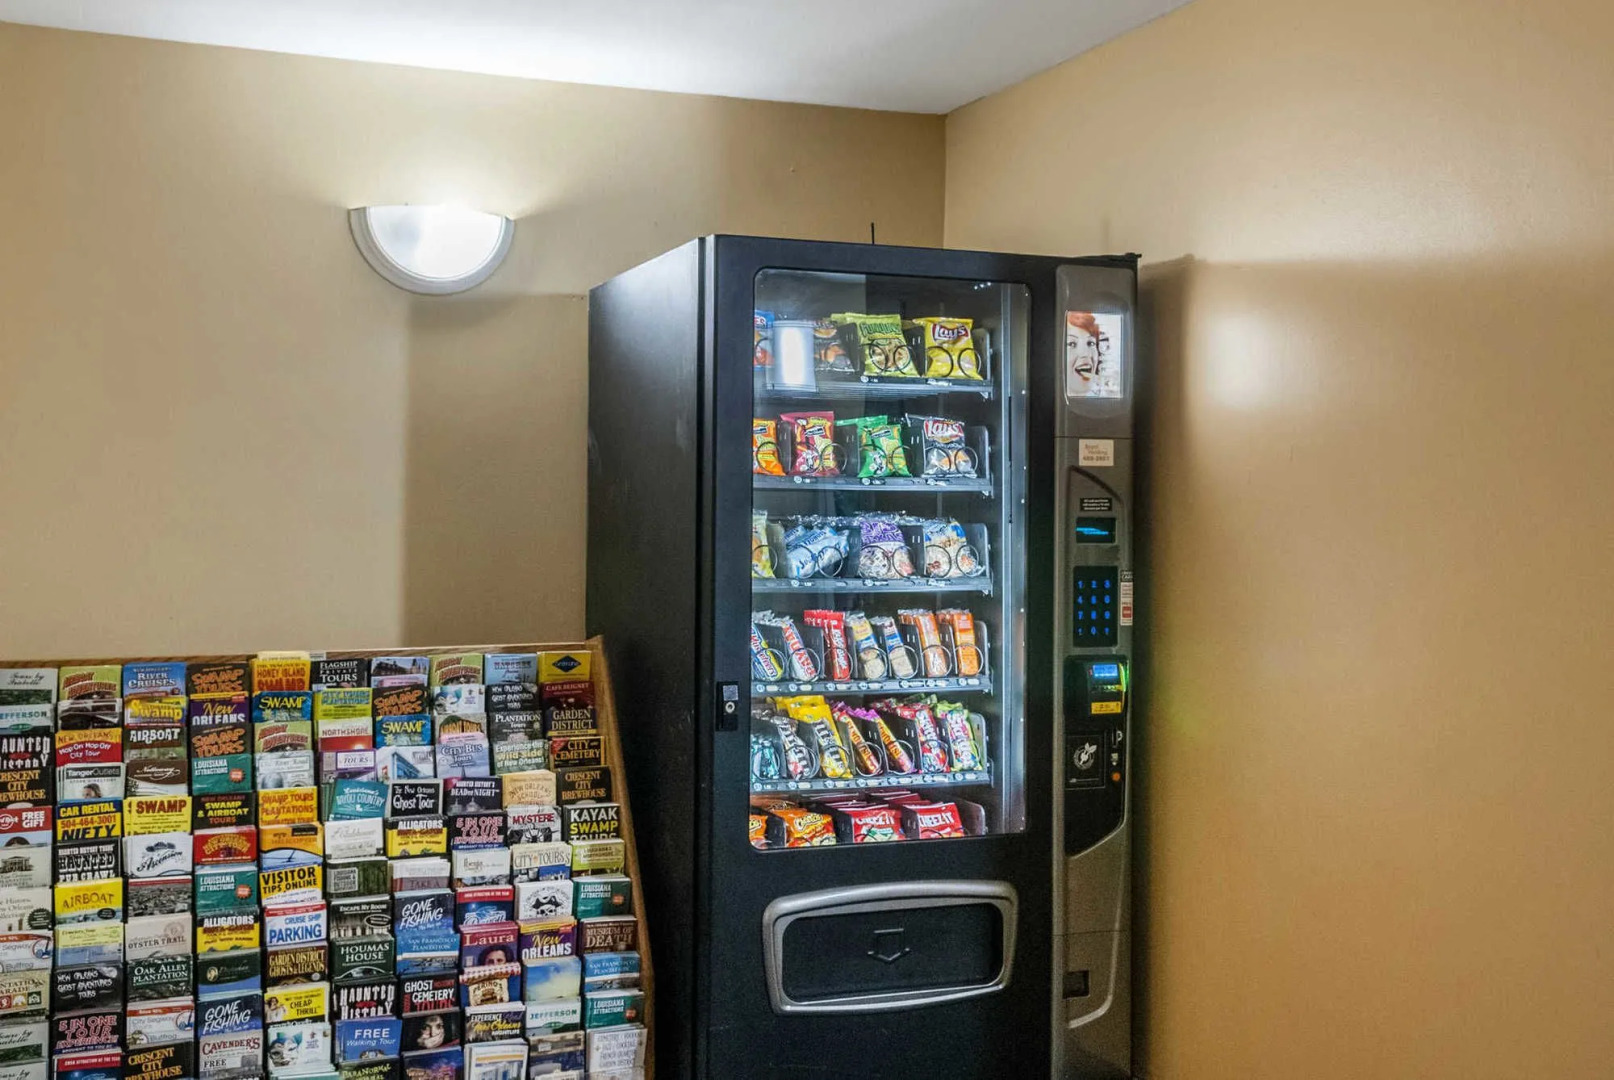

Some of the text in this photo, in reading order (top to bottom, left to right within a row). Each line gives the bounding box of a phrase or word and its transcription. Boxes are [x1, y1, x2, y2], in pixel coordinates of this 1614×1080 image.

[933, 323, 970, 342] Lay's
[320, 660, 358, 670] FLAGSHIP
[138, 672, 168, 680] RIVER
[191, 669, 244, 684] SWAMP
[320, 674, 358, 683] TOURS
[129, 679, 176, 689] CRUISES
[195, 680, 243, 693] TOURS
[563, 682, 589, 690] BEIGNET
[260, 696, 306, 710] SWAMP
[373, 689, 423, 709] SWAMP
[130, 699, 183, 721] Swamp
[203, 702, 237, 716] New
[377, 700, 423, 717] TOURS
[553, 709, 591, 721] GARDEN
[0, 711, 47, 720] EFFERSON
[495, 713, 541, 723] PLANTATION
[381, 720, 425, 733] SWAMP
[551, 719, 593, 731] DISTRICT
[58, 731, 111, 743] NEW ORLEANS
[129, 728, 181, 744] AIRBOAT
[191, 727, 245, 747] SWAMP
[322, 727, 369, 737] NORTHSHORE
[197, 741, 245, 758] TOURS
[567, 740, 589, 750] CITY
[69, 749, 101, 759] City Tour
[554, 748, 600, 761] CEMETERY
[194, 759, 228, 769] LOUISIANA
[0, 769, 41, 781] RESCENT
[66, 766, 120, 778] TangerOutlets
[195, 767, 228, 775] ATTRACTIONS
[565, 771, 601, 782] CRESCENT
[7, 780, 29, 792] CITY
[404, 785, 435, 794] New Orleans
[575, 780, 592, 789] CITY
[290, 793, 314, 802] TOURS
[473, 788, 496, 796] NIGHT
[561, 788, 606, 800] BREWHOUSE
[136, 799, 187, 815] SWAMP
[205, 801, 242, 810] SWAMP
[336, 793, 386, 808] BAYOU COUNTRY
[393, 794, 435, 811] Ghost Tour
[22, 810, 45, 820] FREE
[60, 802, 116, 817] CAR RENTAL
[197, 808, 249, 818] & AIRBOAT
[570, 807, 618, 823] KAYAK
[22, 818, 45, 829] GIFT
[209, 816, 237, 824] TOURS
[397, 820, 444, 830] ALLIGATORS
[478, 816, 503, 828] ONE
[513, 813, 555, 825] MYSTERE
[61, 825, 116, 841] NIFTY
[461, 826, 498, 839] TOUR
[569, 821, 619, 835] SWAMP
[58, 852, 115, 873] HAUNTED
[514, 855, 533, 869] CITY
[538, 851, 565, 865] TOURS
[58, 869, 116, 882] PUB CRAWL
[200, 875, 235, 885] LOUISIANA
[262, 867, 316, 887] VISITOR
[200, 883, 236, 892] ATTRACTIONS
[263, 878, 317, 894] TIPS ONLINE
[581, 884, 612, 892] LOUISIANA
[62, 892, 115, 909] AIRBOAT
[580, 890, 611, 899] ATTRACTIONS
[339, 903, 388, 913] ESCAPE ROOM
[401, 898, 435, 917] GONE
[203, 916, 255, 929] ALLIGATORS
[284, 913, 322, 926] CRUISE SHIP
[400, 908, 444, 930] FISHING
[269, 924, 323, 944] PARKING
[587, 927, 621, 937] MUSEUM
[623, 926, 632, 934] OF
[128, 937, 186, 949] OYSTER TRAIL
[464, 934, 515, 946] Laura
[532, 934, 565, 948] New
[586, 934, 632, 948] DEATH
[340, 942, 390, 955] HOUMAS
[521, 943, 572, 960] ORLEANS
[269, 949, 325, 967] GARDEN DISTRICT
[345, 951, 384, 964] HOUSE
[134, 963, 187, 976] OAK ALLEY
[298, 961, 325, 973] LEGENDS
[132, 971, 188, 984] PLANTATION
[57, 984, 76, 993] GHOST
[404, 979, 434, 993] GHOST
[78, 990, 97, 999] TOURS
[340, 984, 395, 1006] HAUNTED
[411, 988, 455, 1003] CEMETERY
[205, 1000, 242, 1020] GONE
[289, 999, 313, 1010] CHEAP
[296, 1005, 318, 1016] THRILL
[341, 1000, 393, 1020] HISTORY
[593, 999, 624, 1009] LOUISIANA
[593, 1006, 624, 1015] ATTRACTIONS
[529, 1009, 577, 1020] JEFFERSON
[87, 1015, 118, 1029] ONE
[203, 1009, 251, 1035] FISHING
[65, 1026, 112, 1041] TOUR
[354, 1027, 391, 1040] FREE
[202, 1036, 261, 1056] CAVENDER'S
[346, 1037, 396, 1048] Walking Tour
[128, 1047, 175, 1065] CRESCENT
[141, 1059, 163, 1073] CITY
[203, 1058, 227, 1069] FREE
